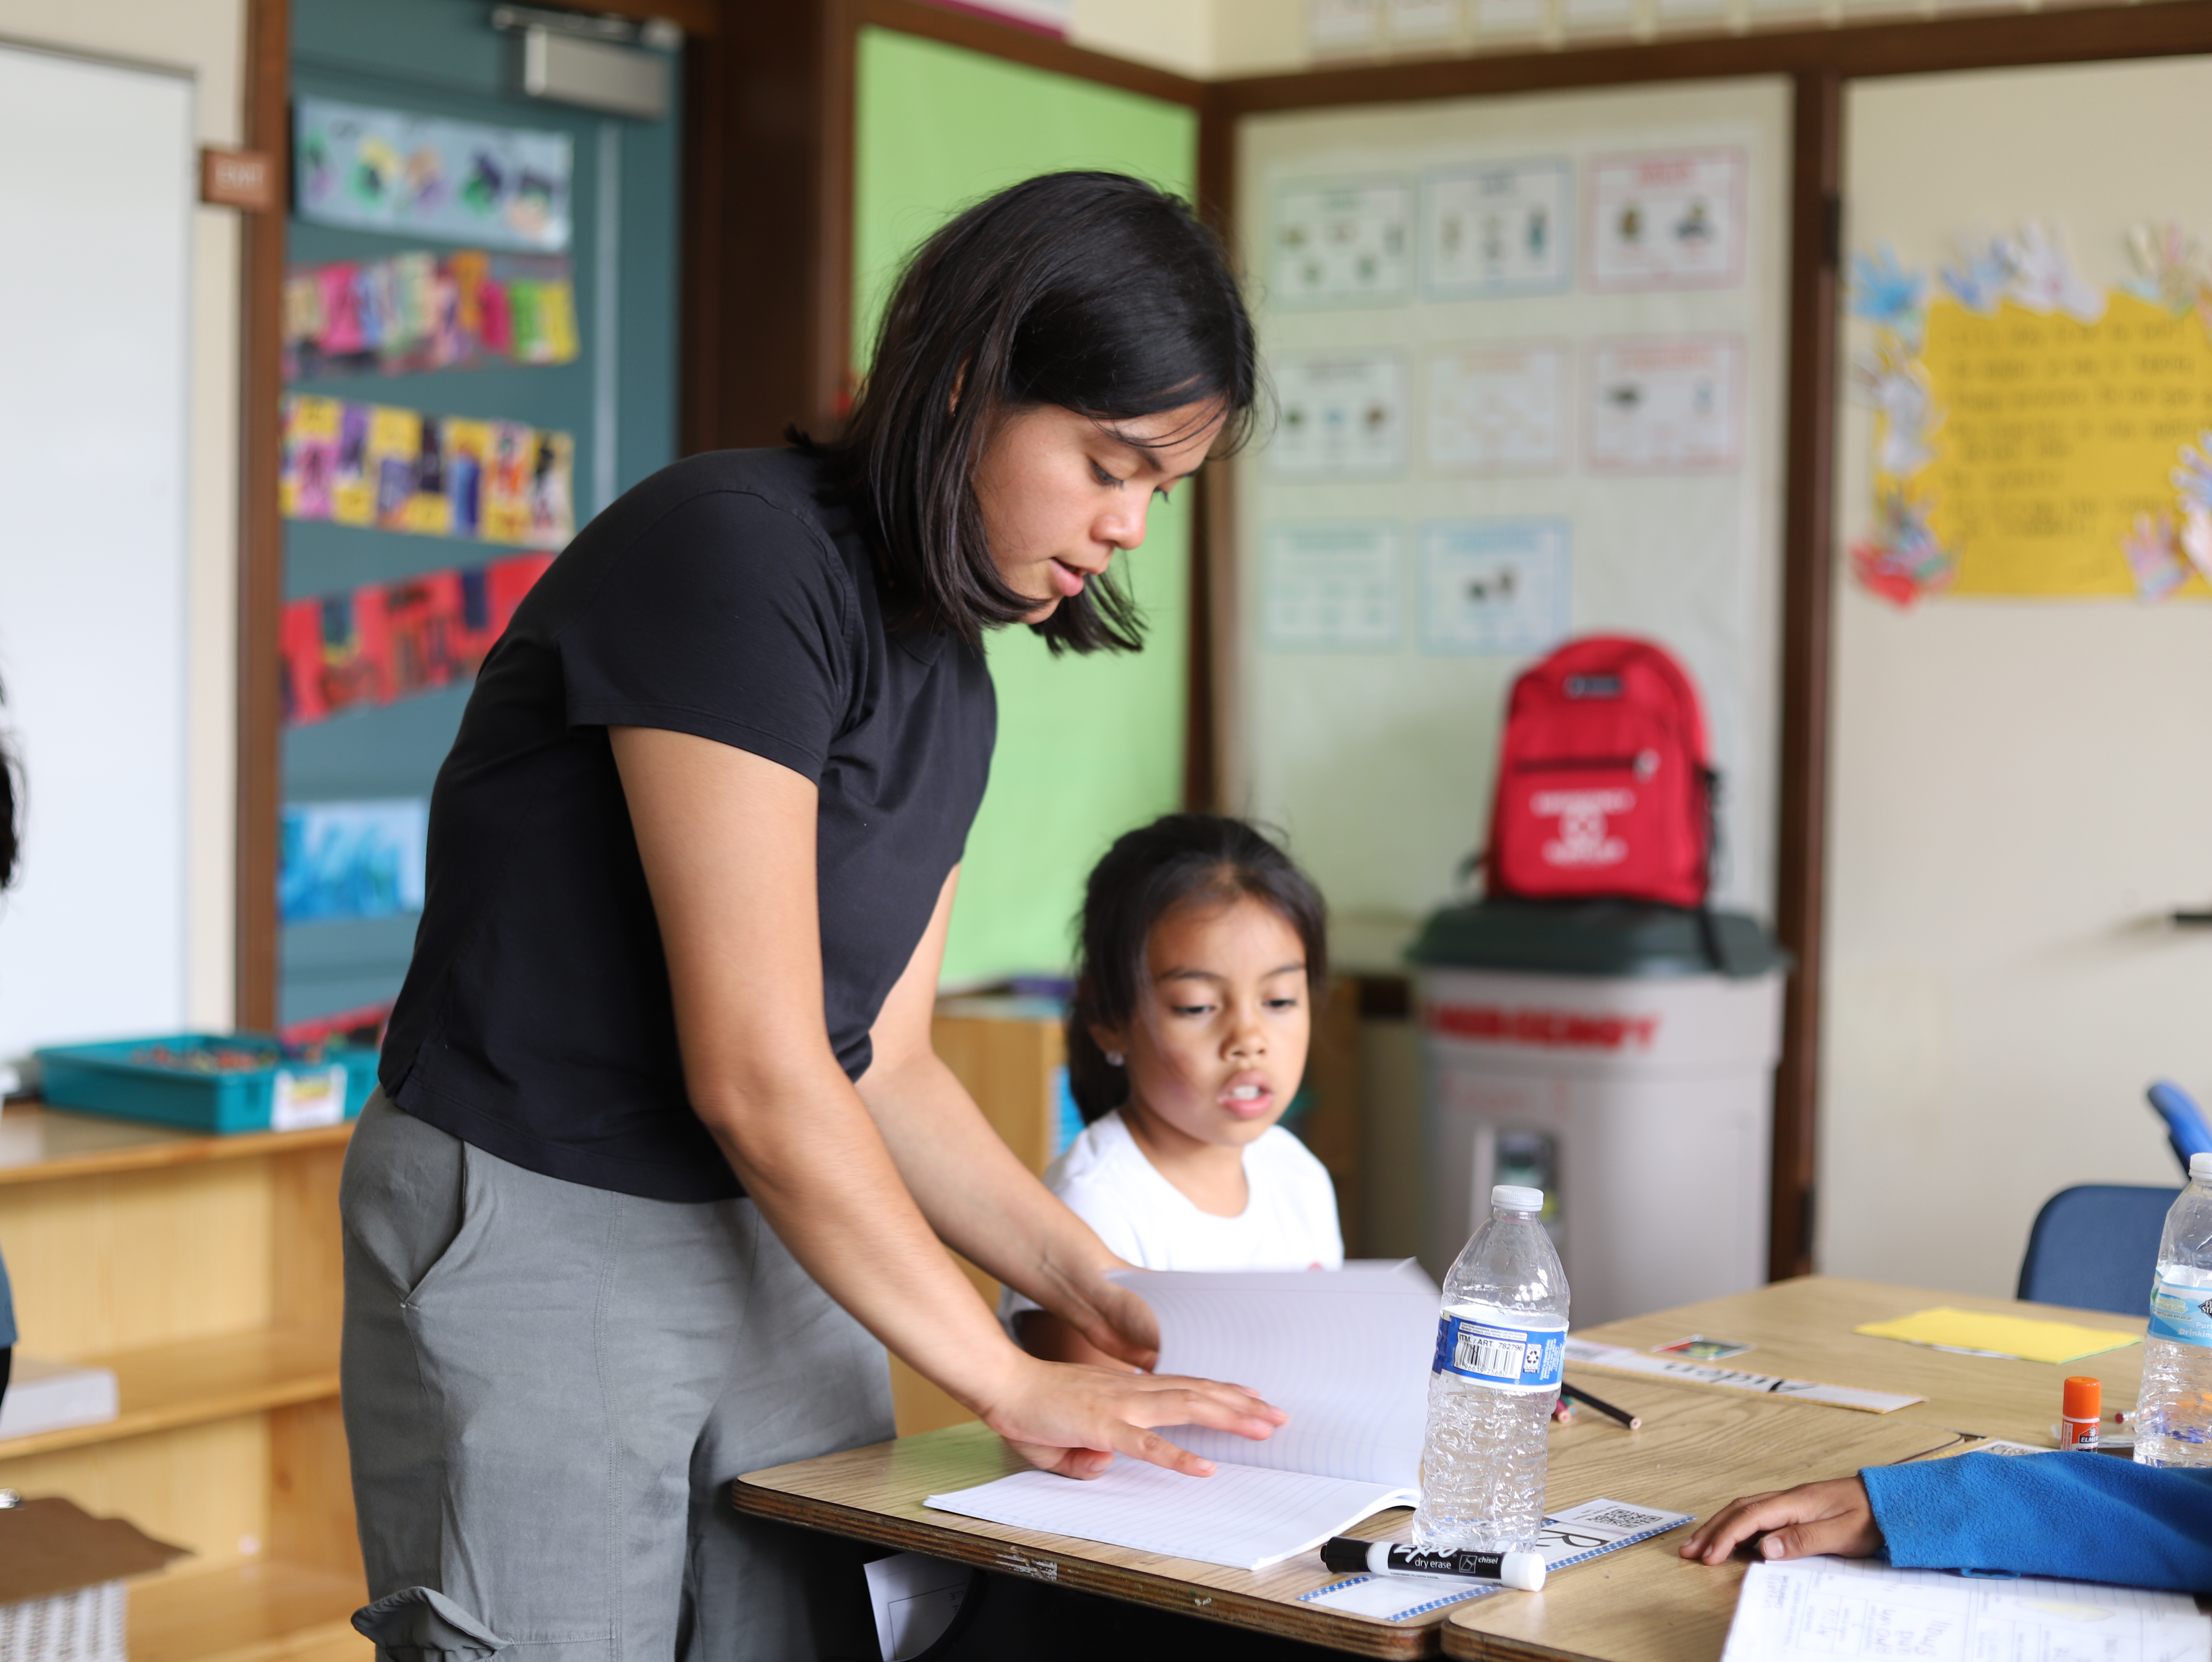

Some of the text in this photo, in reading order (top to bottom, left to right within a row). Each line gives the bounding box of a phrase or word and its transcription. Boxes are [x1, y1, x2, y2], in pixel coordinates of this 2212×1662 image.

[1459, 1334, 1472, 1343] ITM.
[1477, 1339, 1494, 1348] ART.
[1499, 1342, 1524, 1352] 782796
[1464, 1364, 1484, 1374] 96619
[1487, 1369, 1507, 1377] 75680
[1393, 1544, 1458, 1563] EXPO
[1415, 1558, 1452, 1569] dry erase
[1774, 1584, 1789, 1609] Comparing
[1896, 1630, 1915, 1655] and
